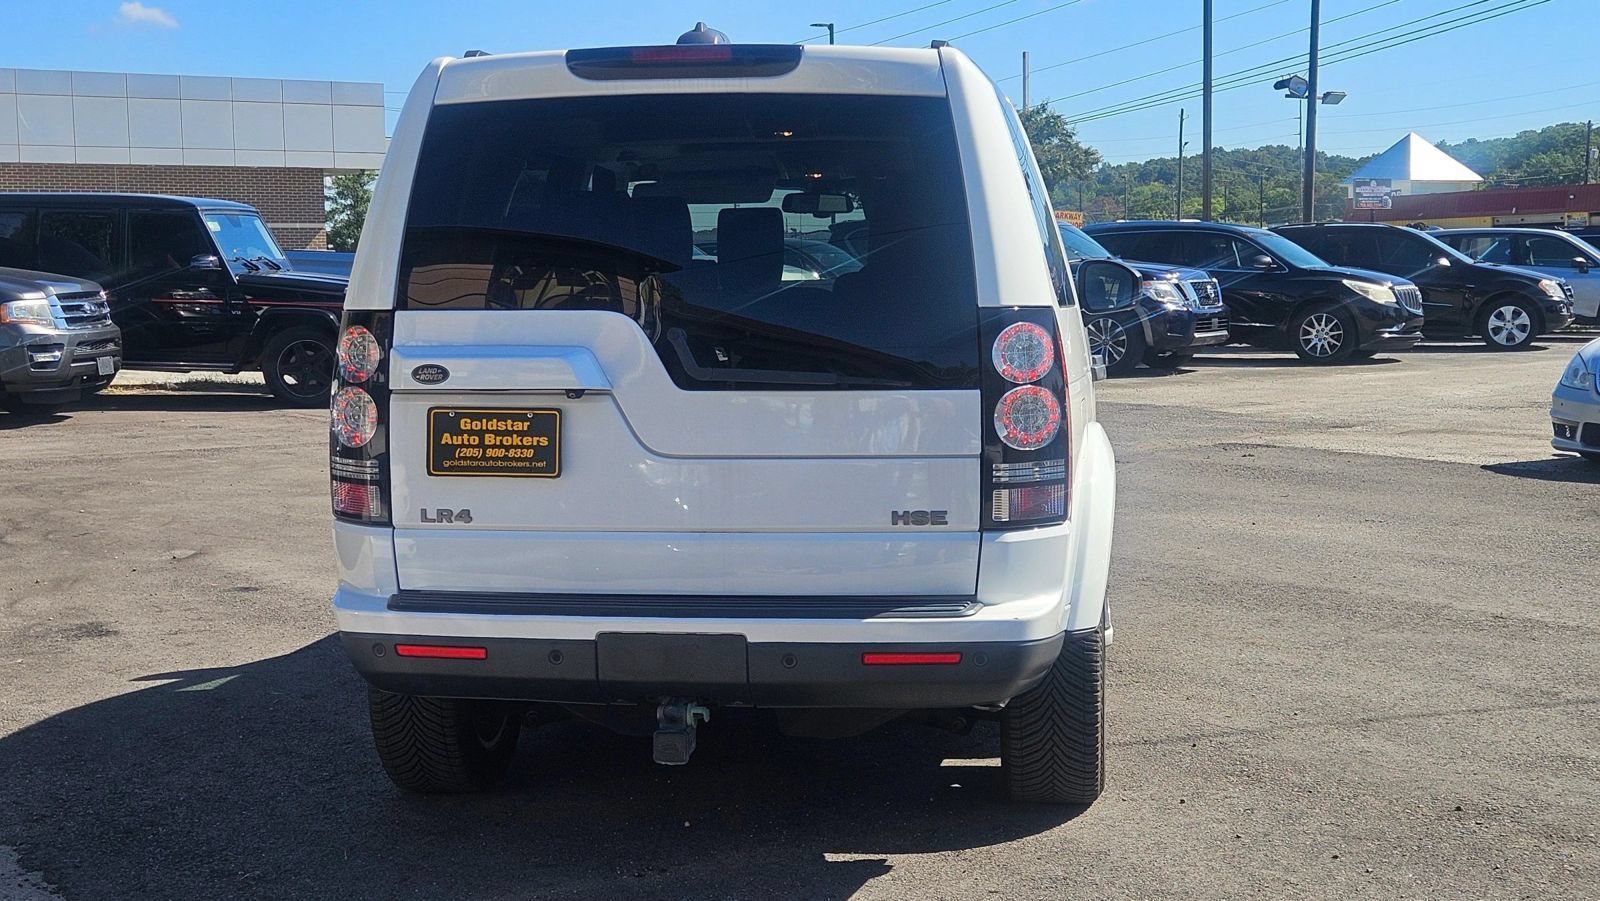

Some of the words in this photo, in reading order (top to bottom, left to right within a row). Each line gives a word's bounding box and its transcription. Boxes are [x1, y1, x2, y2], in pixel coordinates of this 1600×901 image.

[1055, 212, 1081, 220] ARKWAY
[420, 373, 444, 381] ROVER
[460, 418, 530, 431] Goldstar
[441, 433, 479, 445] Auto
[484, 433, 549, 446] Brokers
[455, 447, 483, 459] (205)
[486, 448, 534, 458] 900-8330
[443, 459, 547, 468] goldstarautobrokers.net
[420, 508, 473, 524] LR4
[891, 510, 949, 526] HSE
